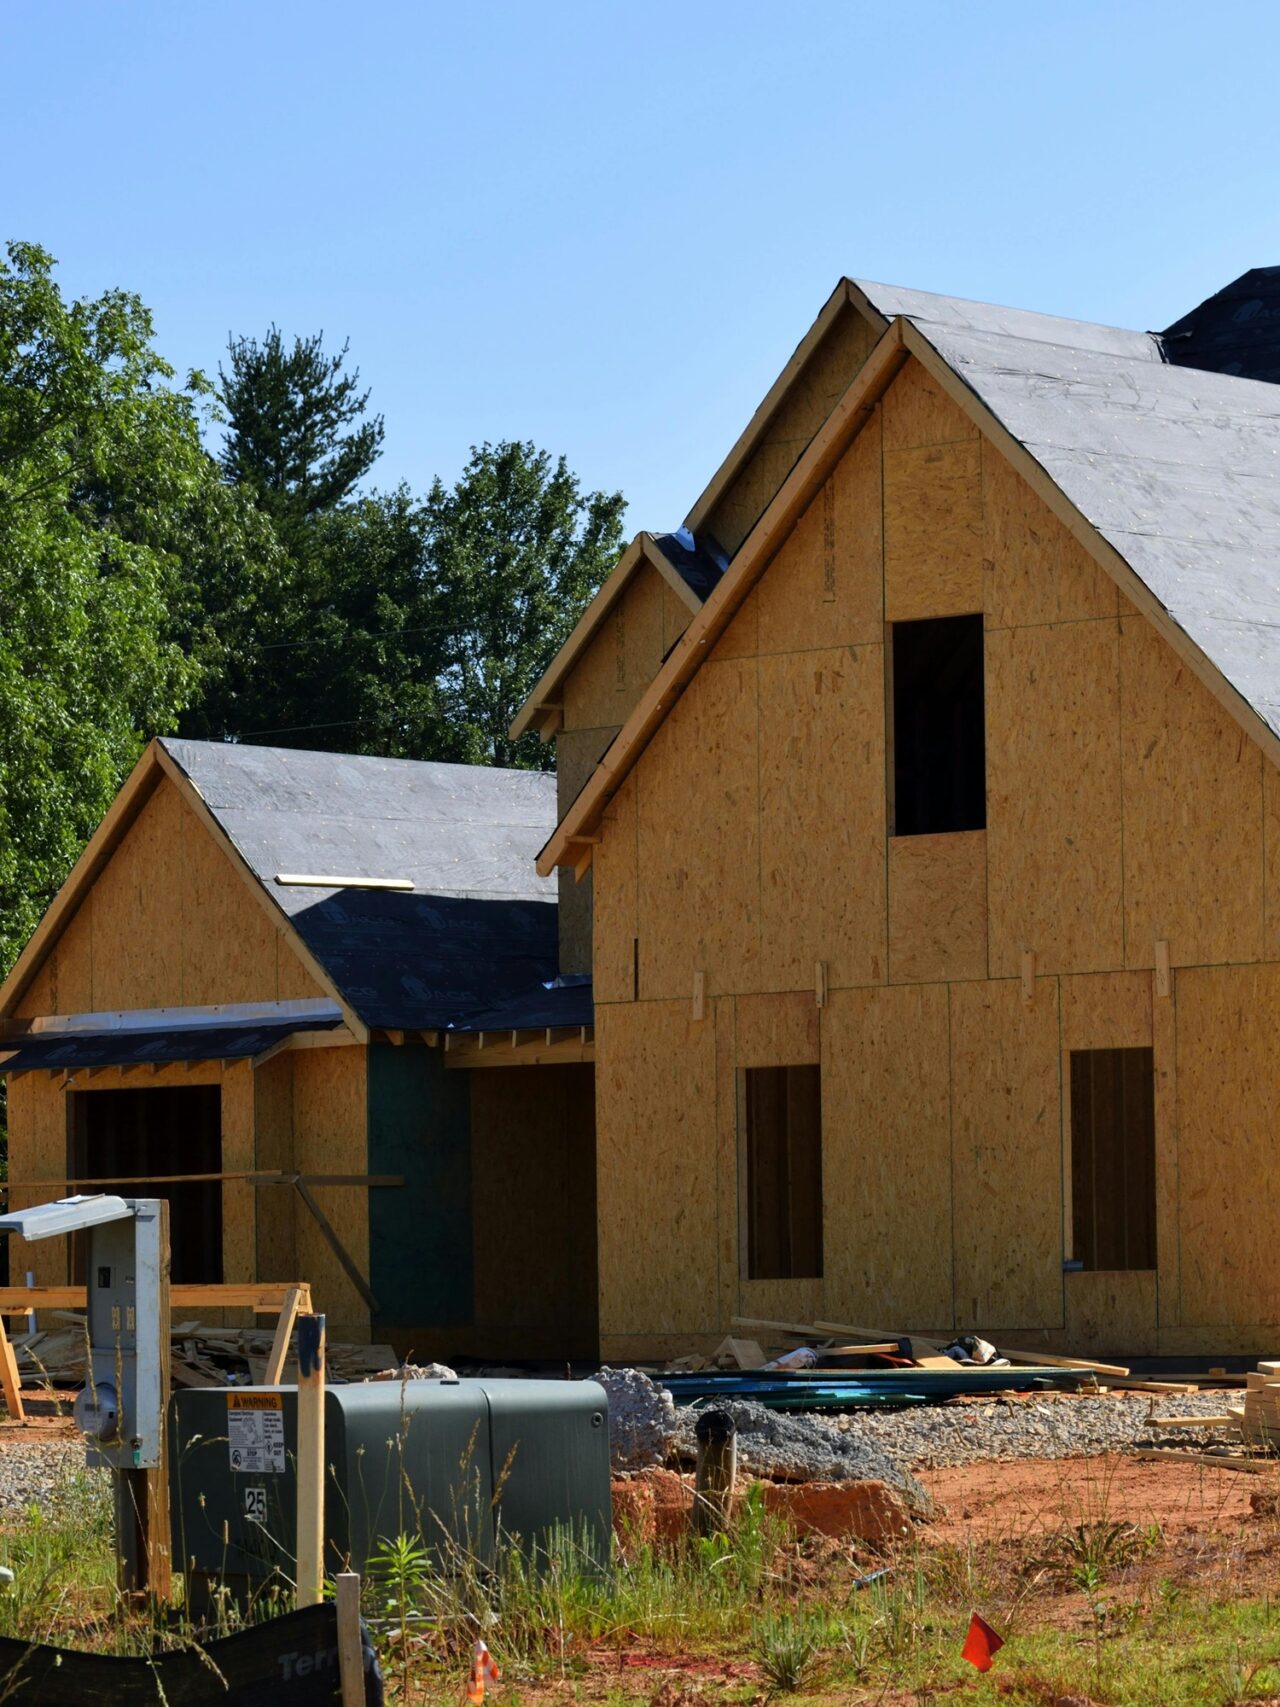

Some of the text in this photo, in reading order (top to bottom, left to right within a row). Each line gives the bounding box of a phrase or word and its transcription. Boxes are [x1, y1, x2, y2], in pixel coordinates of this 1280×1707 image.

[241, 1397, 277, 1409] WARNING
[247, 1491, 265, 1514] 25
[278, 1648, 339, 1681] Terr
